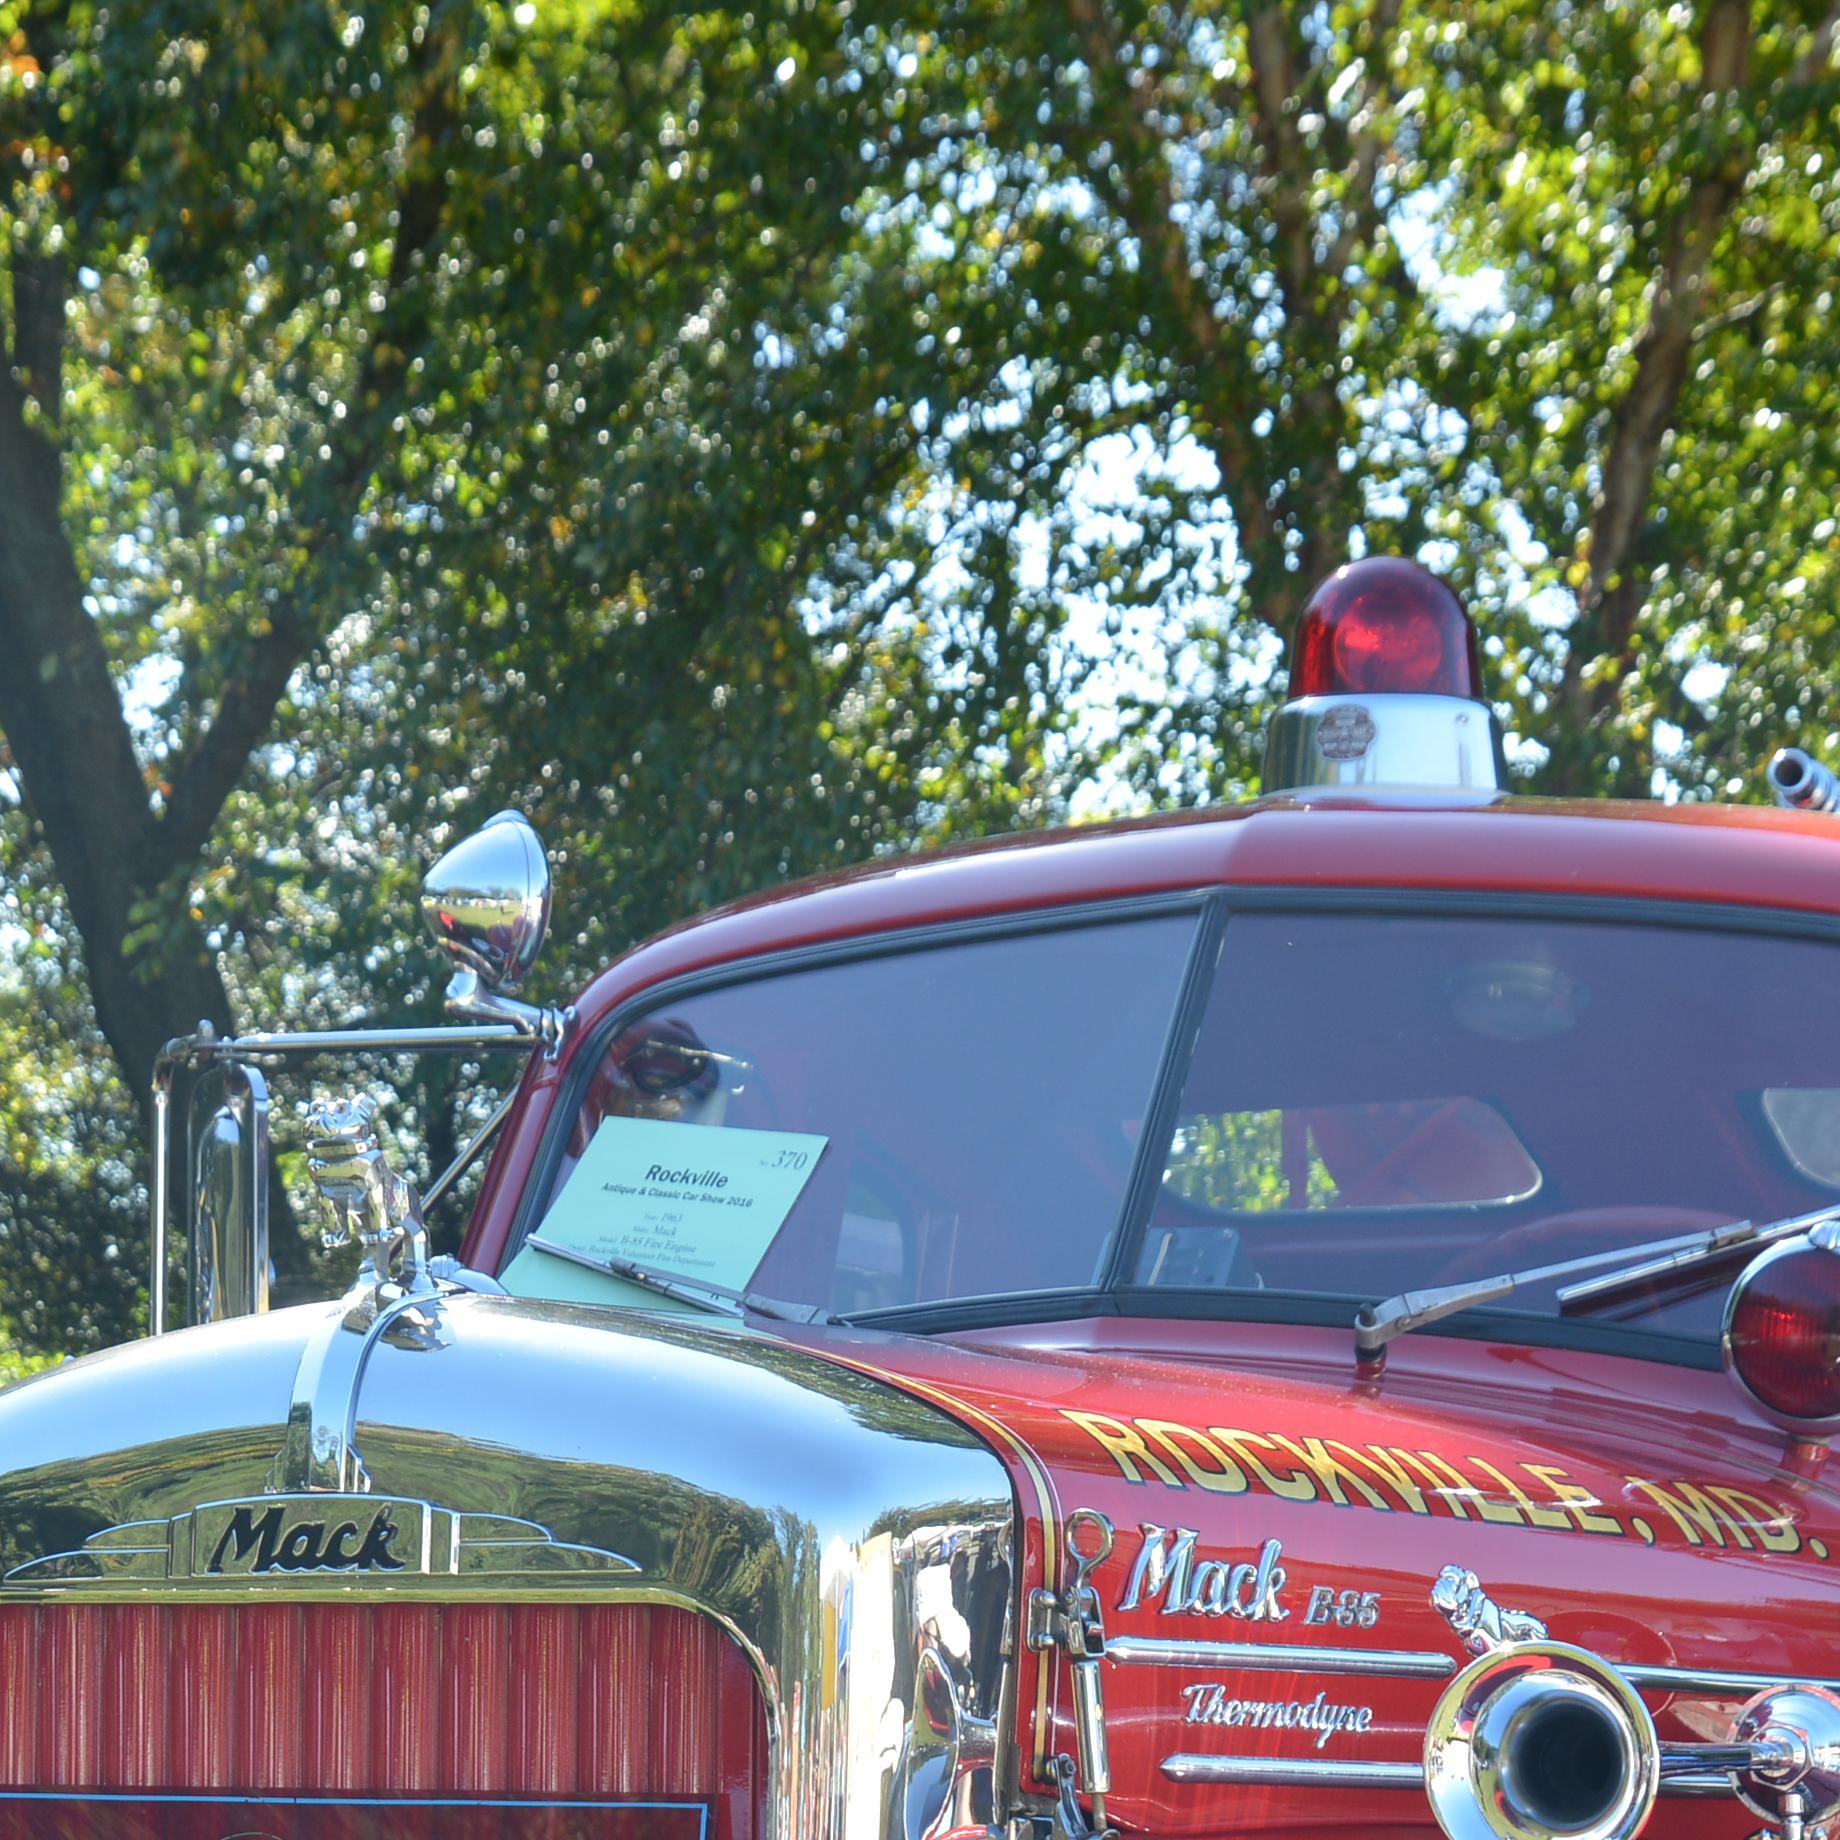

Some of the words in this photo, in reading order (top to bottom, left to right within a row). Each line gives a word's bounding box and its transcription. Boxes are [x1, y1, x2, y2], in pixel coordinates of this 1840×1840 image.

[771, 1149, 808, 1170] 370
[645, 1164, 729, 1188] Rockville
[601, 1182, 637, 1196] Antique
[638, 1186, 647, 1196] &
[648, 1187, 681, 1200] Classic
[682, 1191, 699, 1201] Car
[700, 1192, 725, 1205] Show
[726, 1196, 754, 1207] 2016
[661, 1212, 684, 1222] 1963
[652, 1224, 677, 1237] Mack
[644, 1237, 663, 1249] Fire
[664, 1239, 697, 1254] Engine
[1057, 1408, 1656, 1546] ROCKVILLE,
[1624, 1475, 1832, 1562] MD.
[204, 1501, 406, 1575] Mack
[1118, 1521, 1292, 1625] Mack
[1181, 1682, 1374, 1750] Thermodyne
